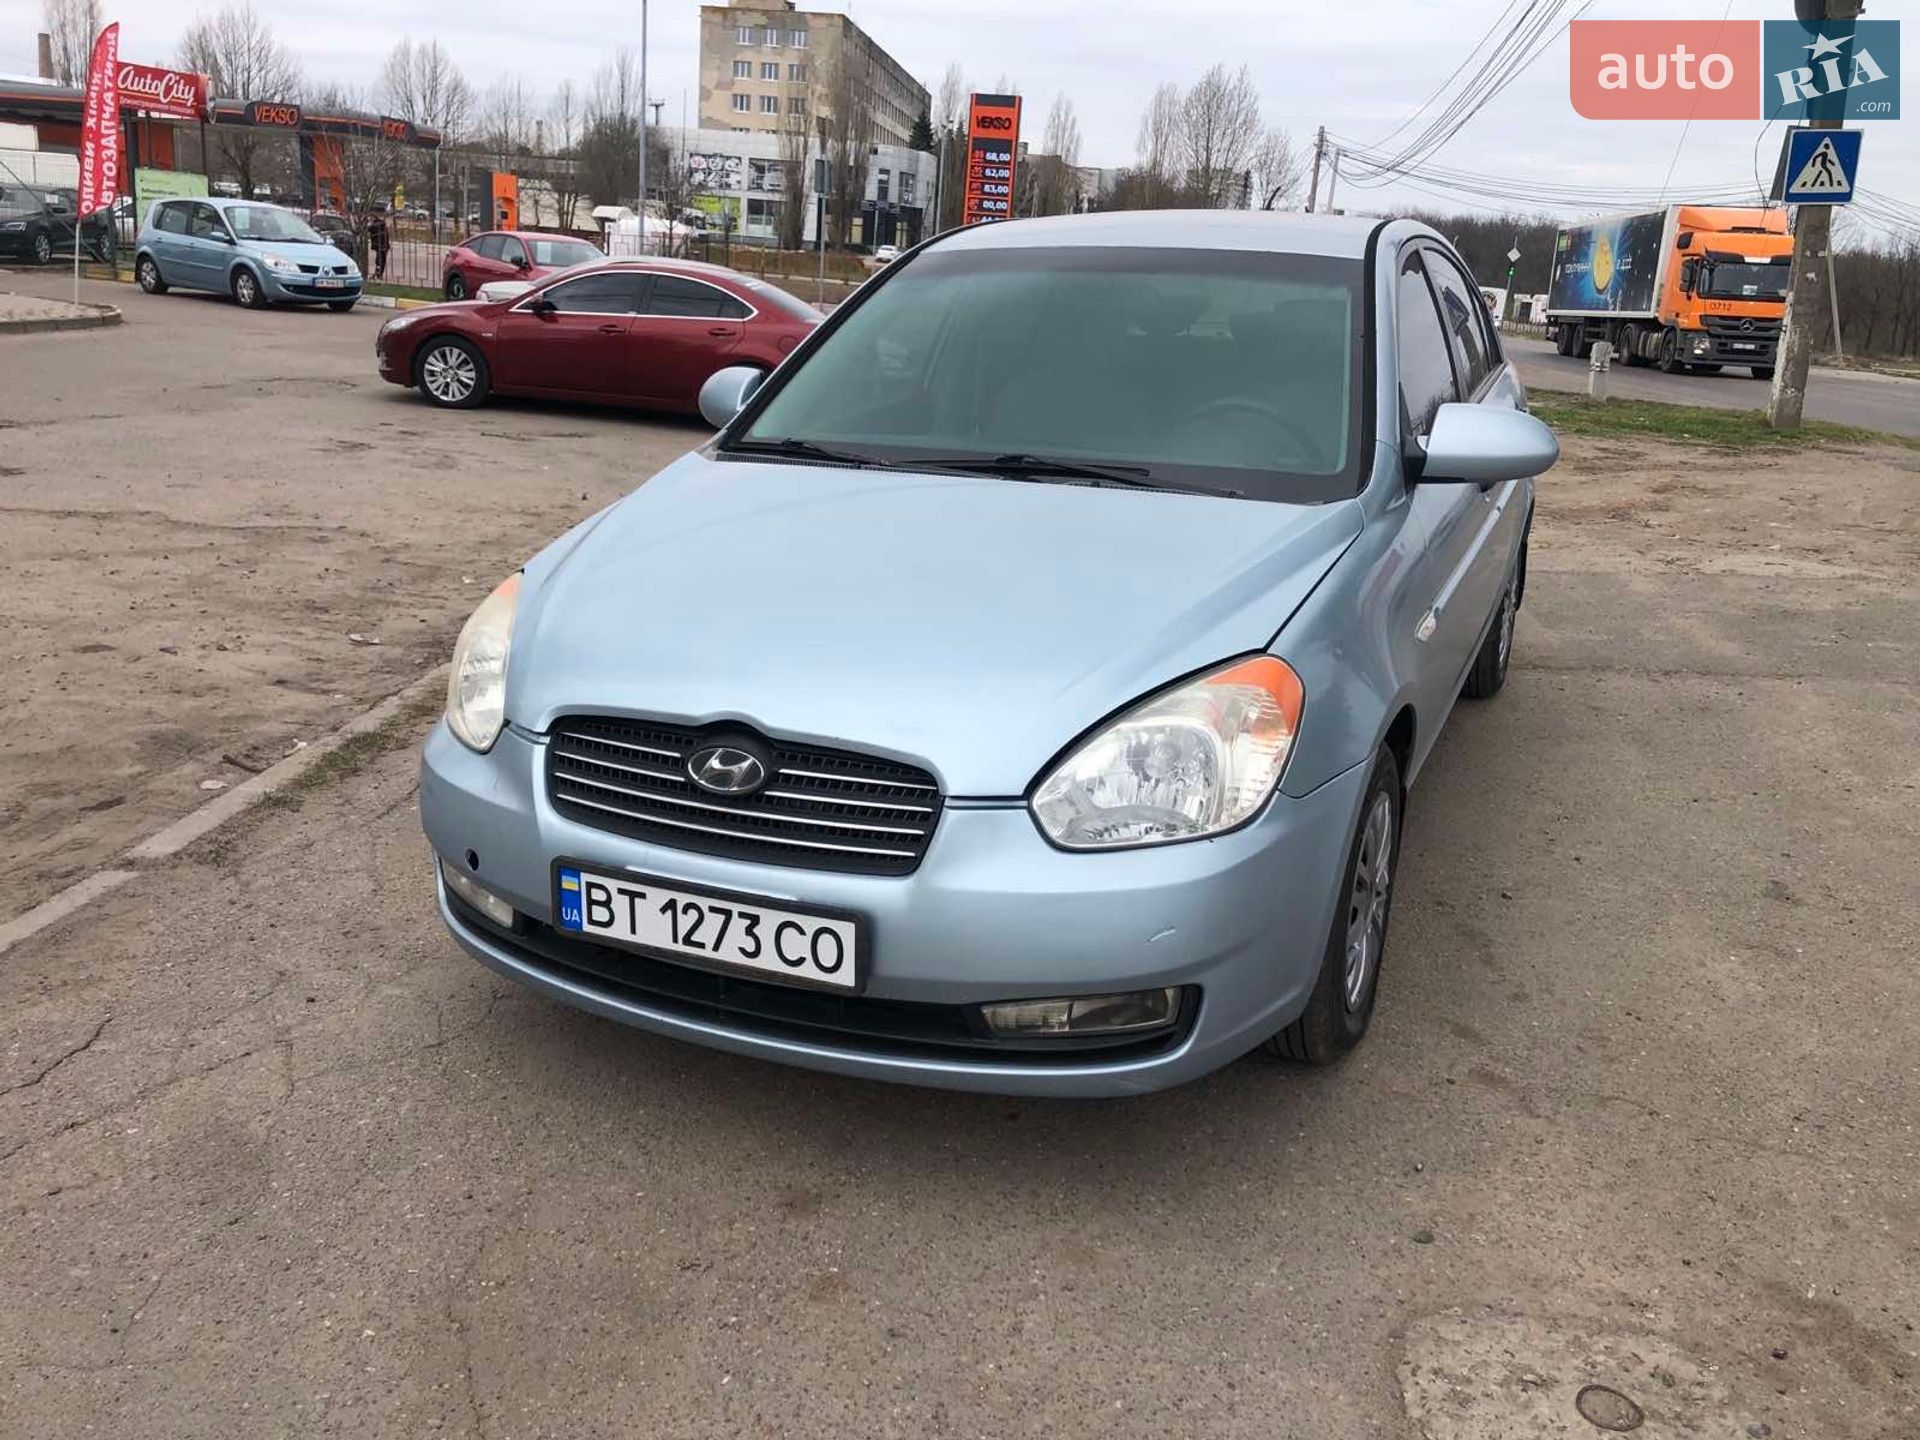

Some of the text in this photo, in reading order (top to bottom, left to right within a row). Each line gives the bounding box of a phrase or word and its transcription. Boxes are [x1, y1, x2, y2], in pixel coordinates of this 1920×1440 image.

[118, 66, 195, 106] AutoCity
[254, 104, 298, 125] VEKSO
[976, 116, 1012, 130] VEKSO
[562, 907, 581, 923] UA
[584, 881, 844, 974] BT 1273 CO
